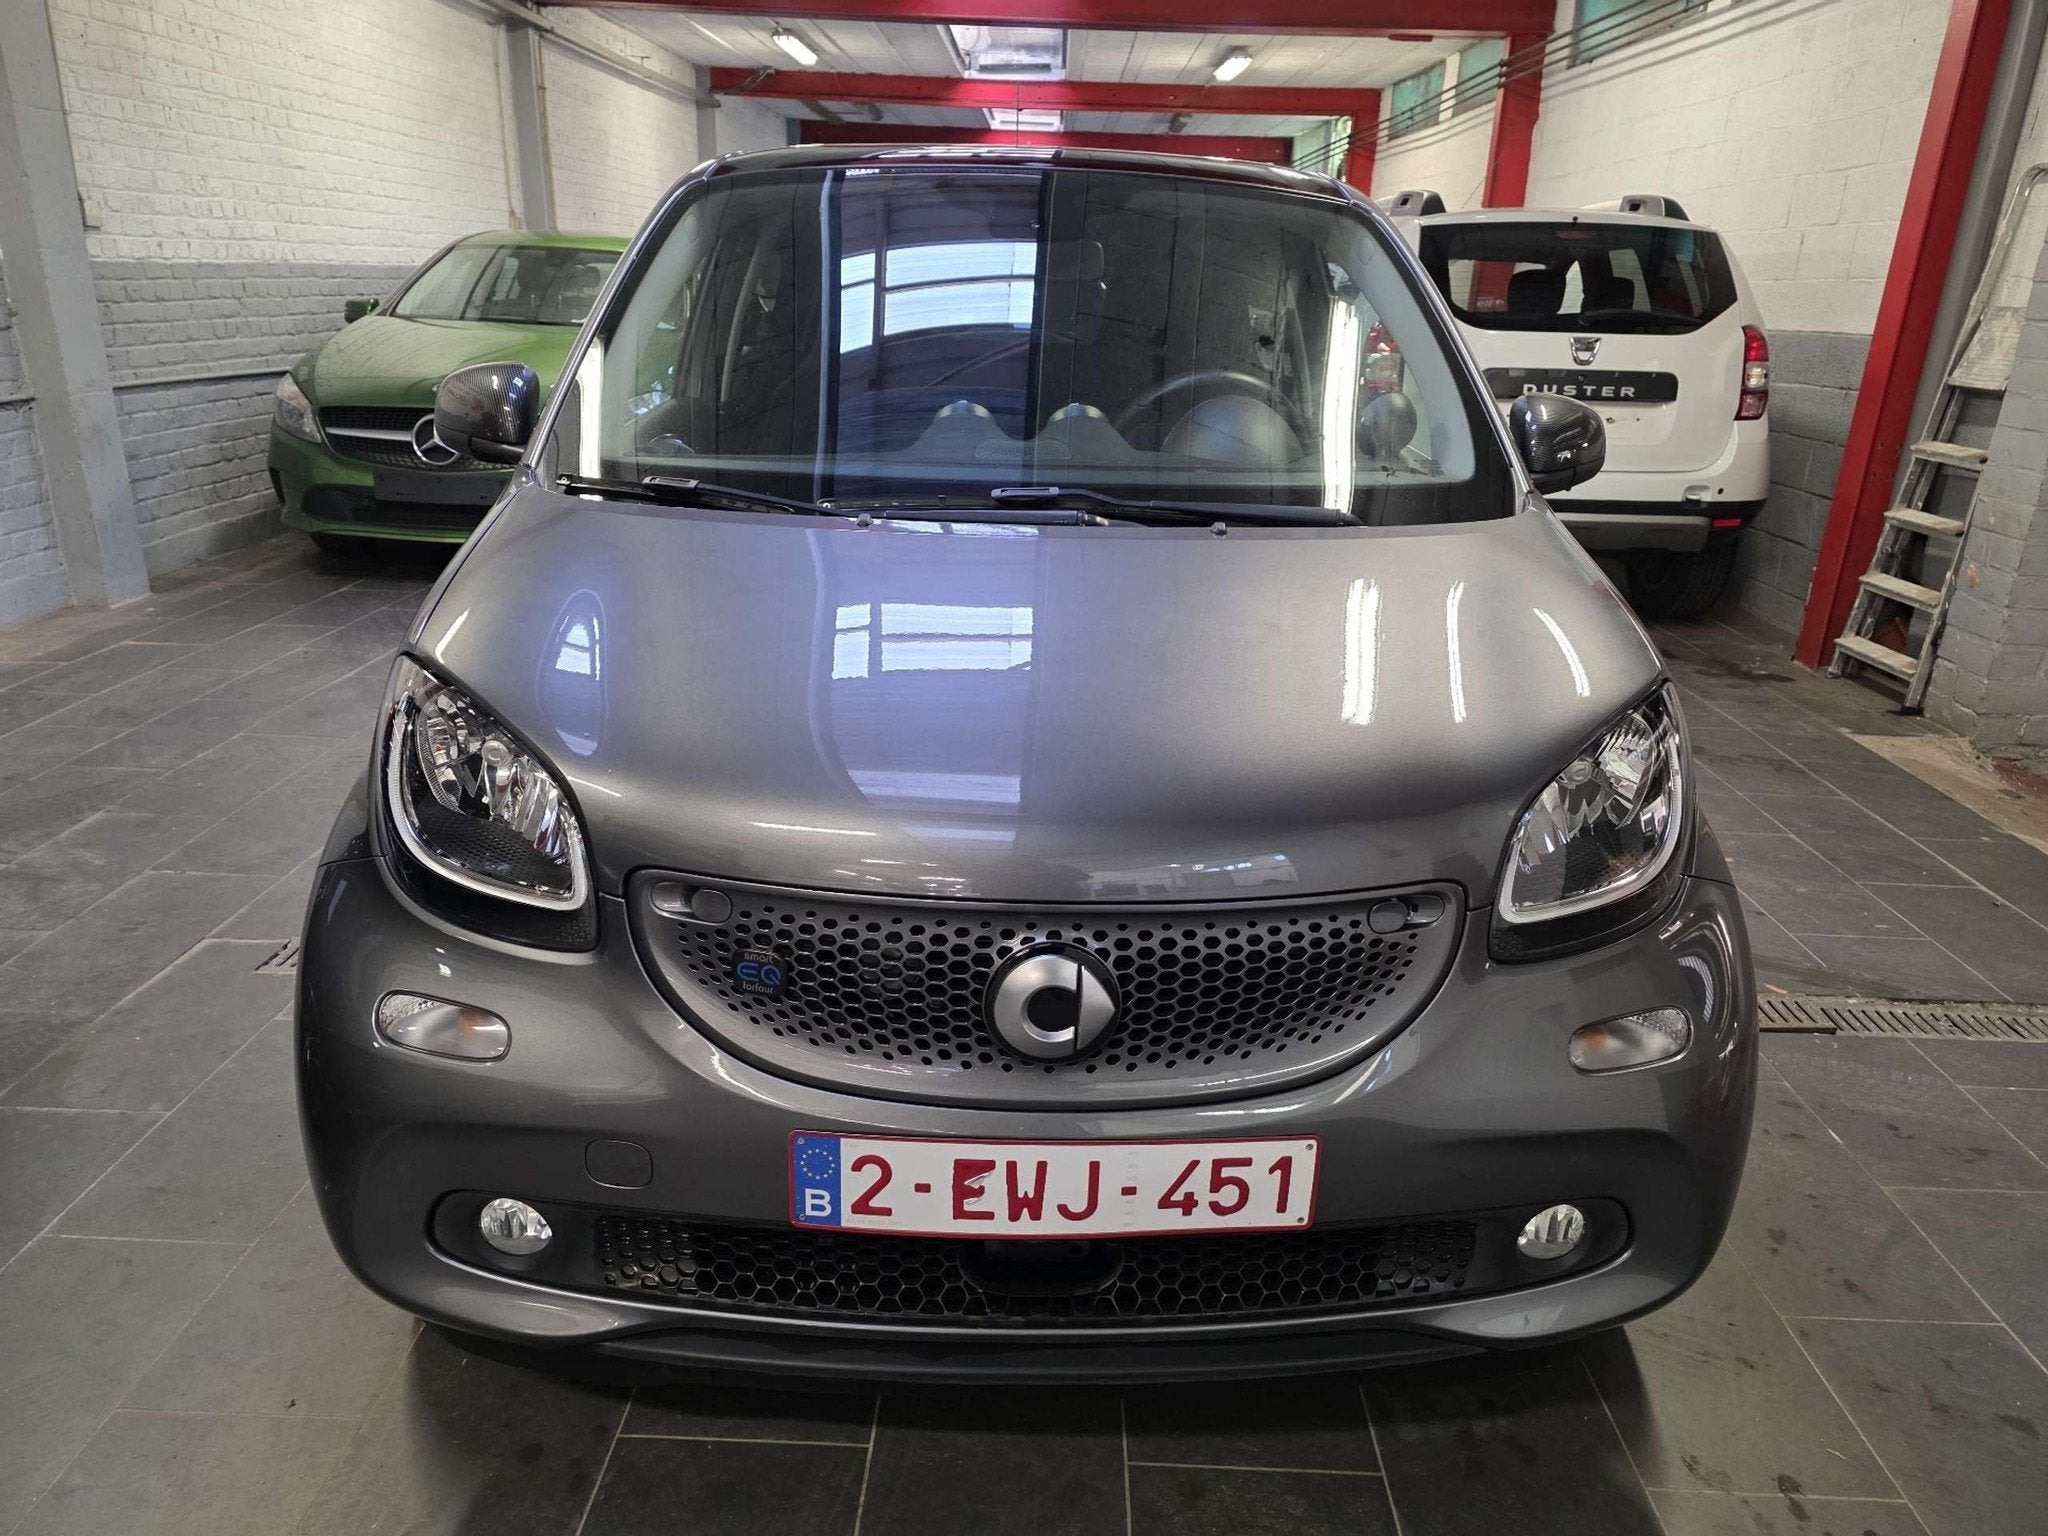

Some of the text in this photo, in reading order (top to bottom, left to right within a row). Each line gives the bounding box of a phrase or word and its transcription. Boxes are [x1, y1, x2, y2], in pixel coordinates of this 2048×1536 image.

[1523, 384, 1635, 397] DUSTER
[744, 952, 773, 963] smart
[737, 962, 781, 985] EQ
[743, 981, 773, 994] forfour
[804, 1188, 832, 1216] B
